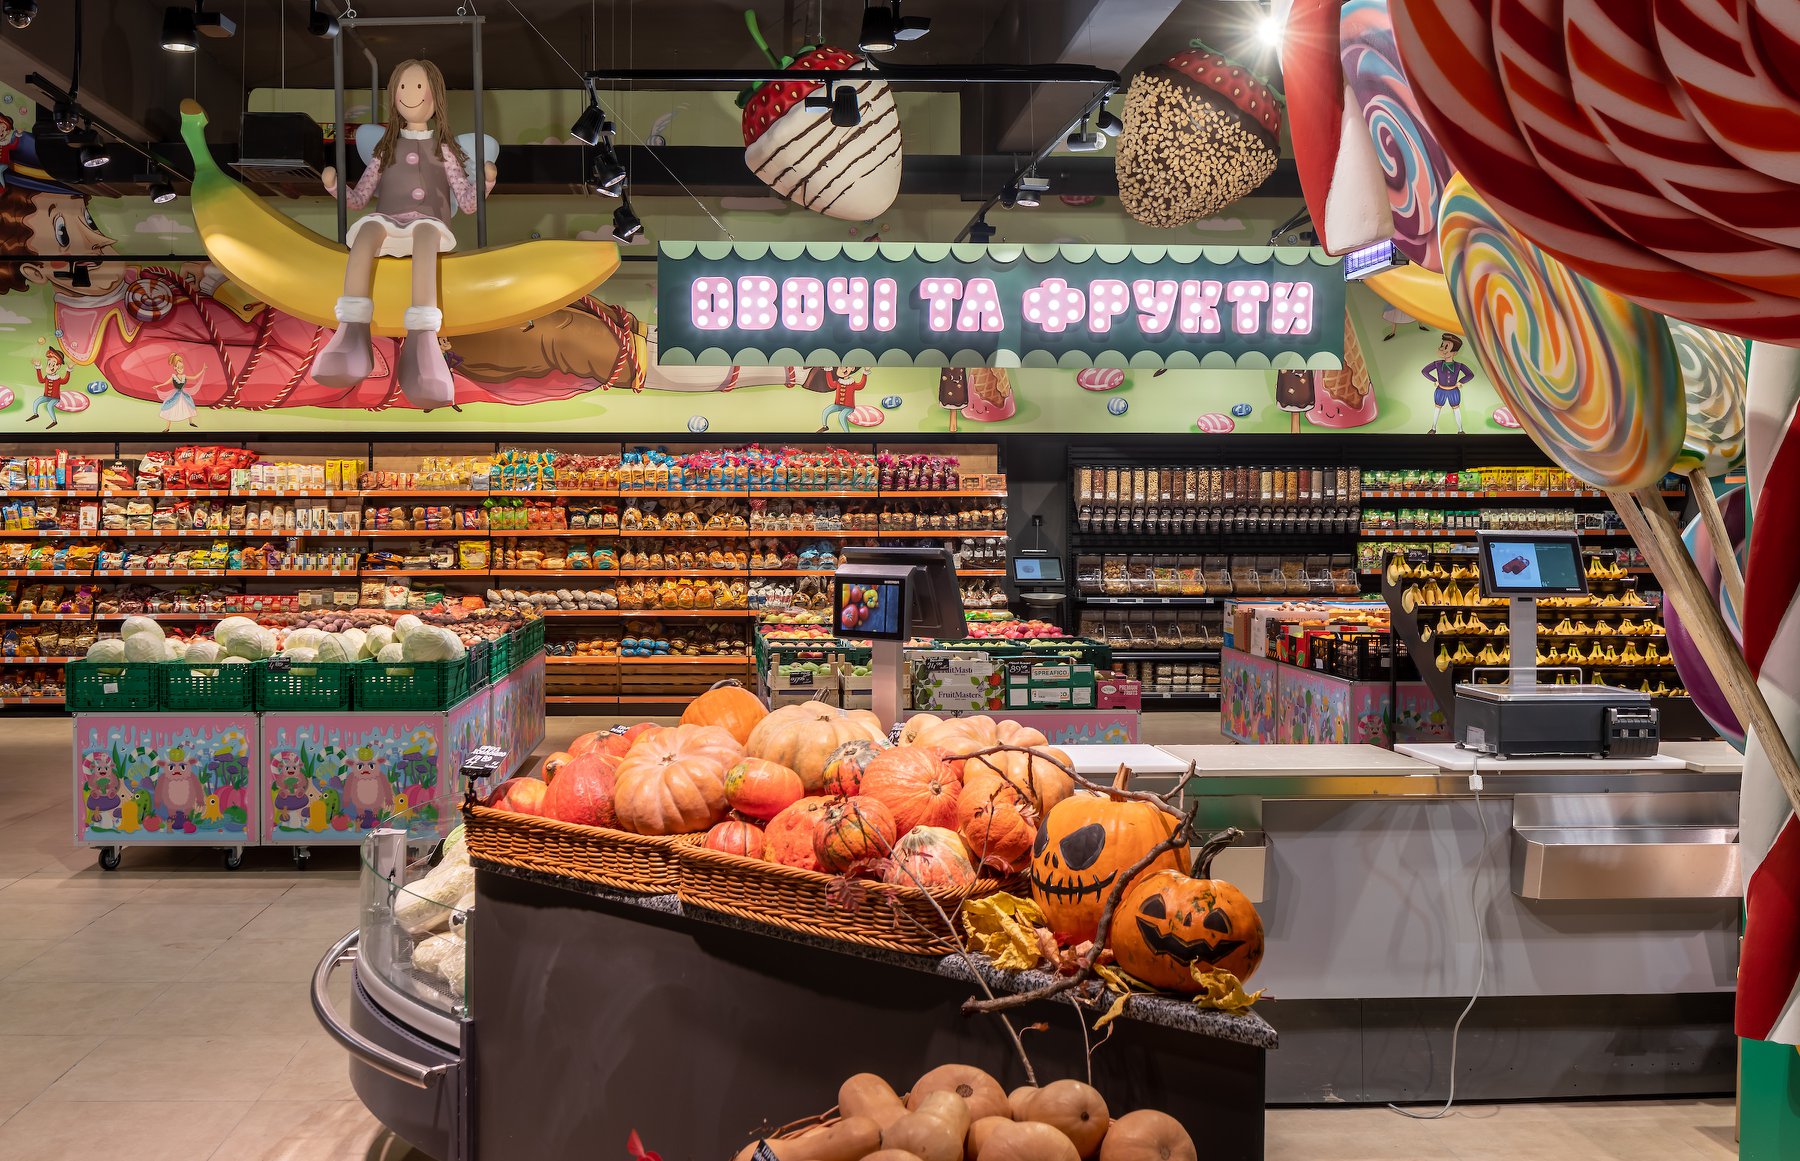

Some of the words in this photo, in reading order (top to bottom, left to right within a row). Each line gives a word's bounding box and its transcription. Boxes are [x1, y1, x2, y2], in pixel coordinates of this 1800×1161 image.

[690, 275, 898, 332] ОВОЧІ
[919, 276, 1005, 333] ТА
[1021, 277, 1314, 335] ФРУКТИ
